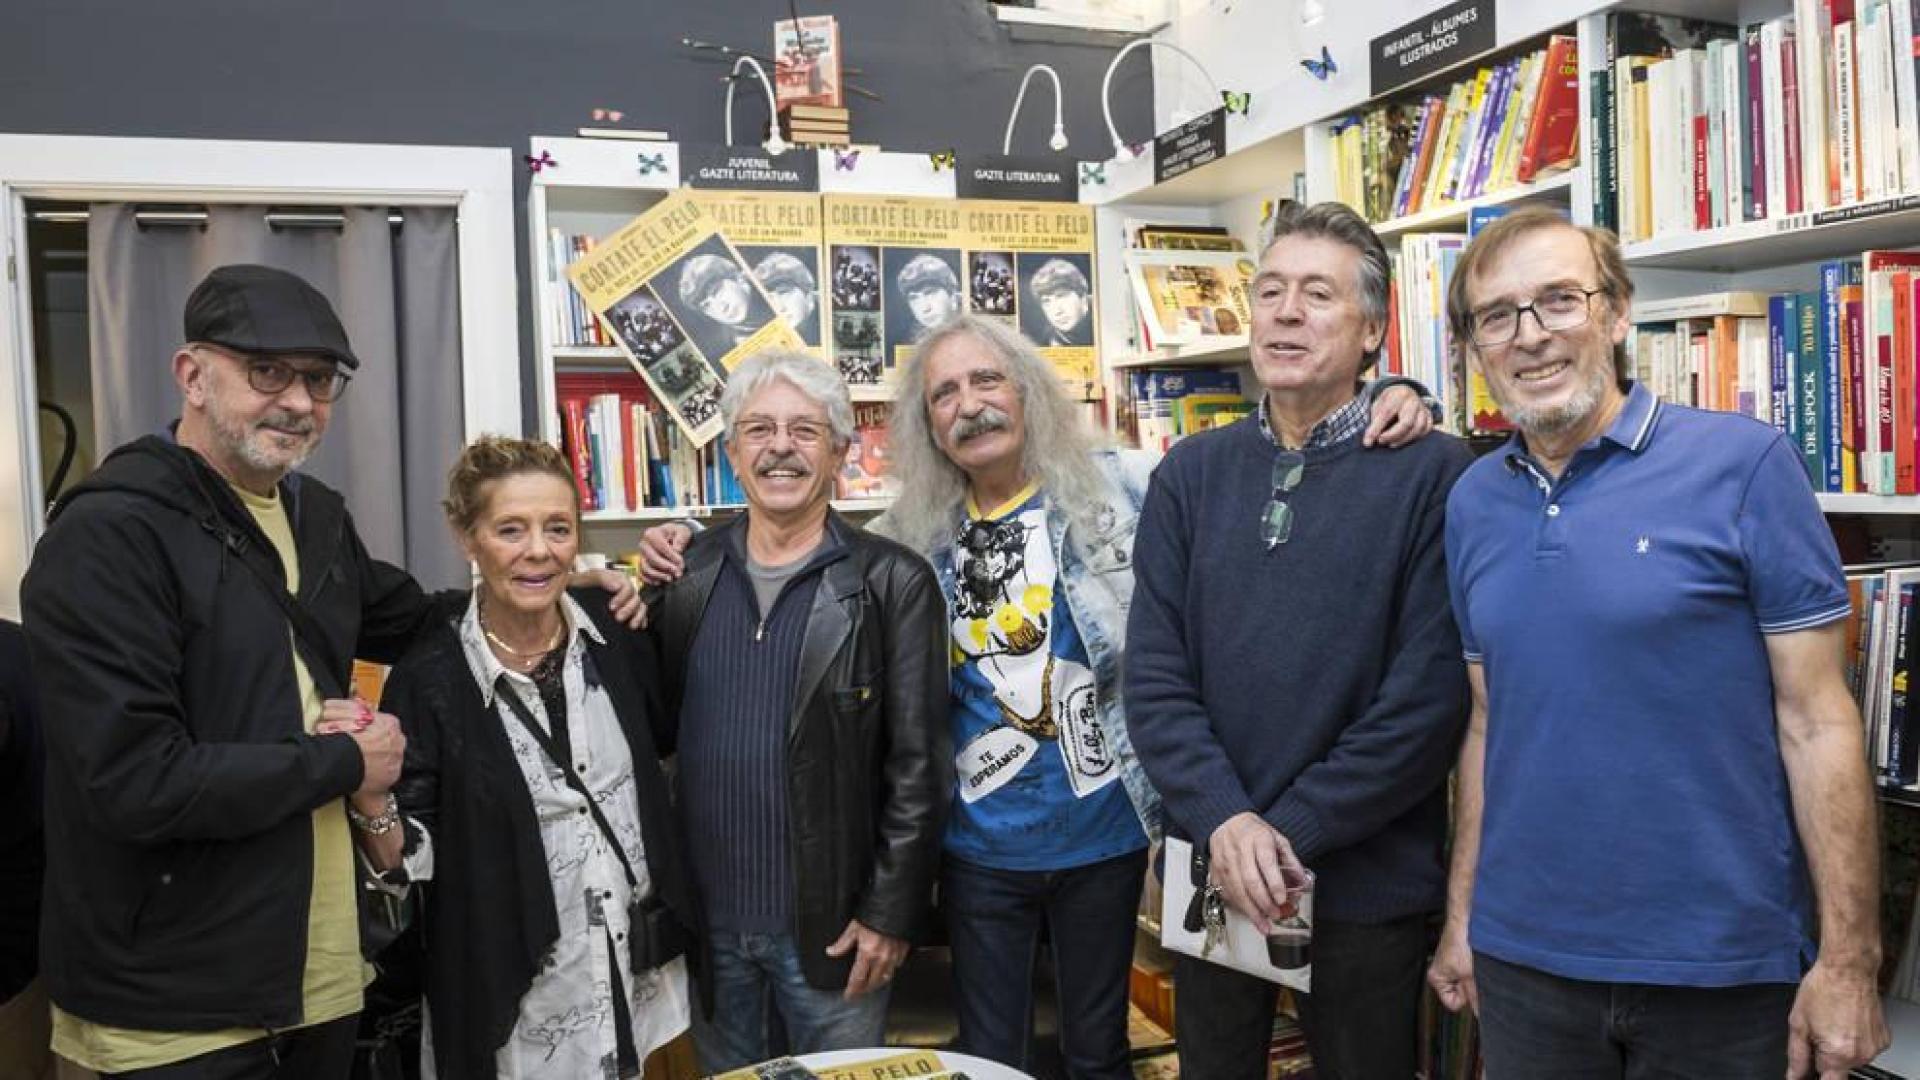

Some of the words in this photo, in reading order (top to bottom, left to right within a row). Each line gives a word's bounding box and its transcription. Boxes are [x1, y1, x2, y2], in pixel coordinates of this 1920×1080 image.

[1384, 31, 1423, 57] INFANTIL
[1431, 7, 1478, 37] ÁLBUMES
[1400, 32, 1458, 66] ILUSTRADOS
[700, 168, 735, 180] GAZTE
[737, 169, 799, 182] LITERATURA
[728, 158, 771, 168] JUVENIL
[974, 169, 1003, 180] GAZTE
[1006, 171, 1060, 183] LITERATURA
[702, 203, 745, 226] TATE
[753, 204, 772, 226] EL
[778, 205, 814, 227] PELO
[832, 203, 897, 228] CORTATE
[903, 206, 917, 229] EL
[924, 208, 960, 230] PELO
[969, 211, 1029, 233] CORTATE
[1035, 213, 1051, 234] EL
[1056, 214, 1089, 235] PELO
[579, 239, 646, 293] CORTATE
[642, 225, 664, 249] EL
[662, 200, 700, 235] PELO
[1804, 371, 1816, 425] SPOCK
[970, 743, 1025, 787] ESPERAMOS
[979, 750, 995, 764] TE
[871, 1057, 933, 1080] PELO
